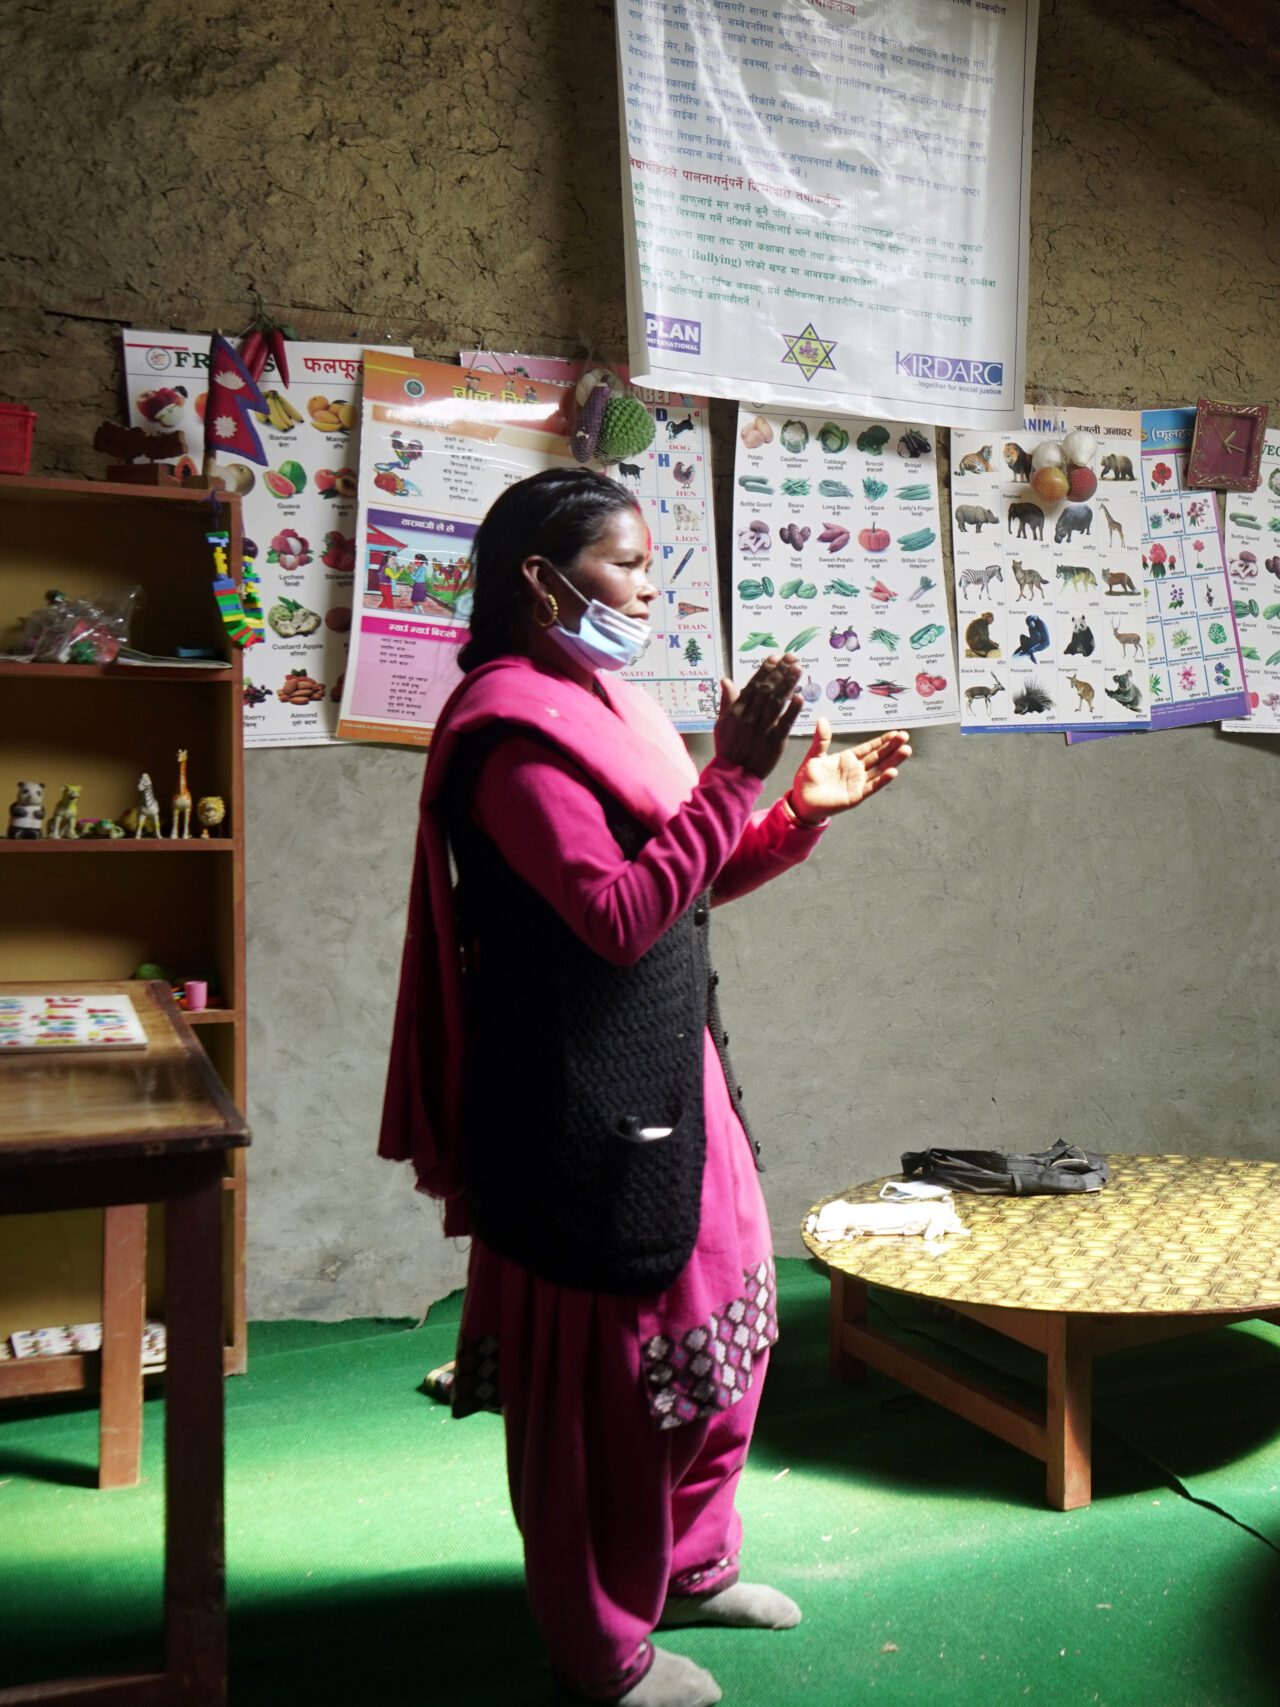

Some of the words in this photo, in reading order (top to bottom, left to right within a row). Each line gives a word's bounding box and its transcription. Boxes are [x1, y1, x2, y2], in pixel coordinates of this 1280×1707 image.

[688, 245, 742, 267] (Bullying)
[646, 318, 699, 343] PLAN
[647, 338, 699, 352] INTERNATIONAL
[896, 351, 1002, 386] KIRDARC
[948, 383, 957, 391] for
[959, 385, 978, 393] social
[979, 388, 1002, 396] justice
[269, 434, 297, 442] Banana
[1103, 426, 1133, 437] जनावर
[669, 444, 690, 452] DOG
[658, 453, 670, 468] H
[823, 458, 847, 466] Cabbage
[660, 499, 669, 514] L
[663, 545, 674, 560] P
[864, 557, 887, 565] Pumpkin
[278, 574, 304, 582] Lychee
[1233, 580, 1257, 588] Mushroom
[665, 590, 676, 604] T
[272, 643, 301, 651] Custard
[302, 643, 324, 651] Apple
[669, 634, 681, 649] X
